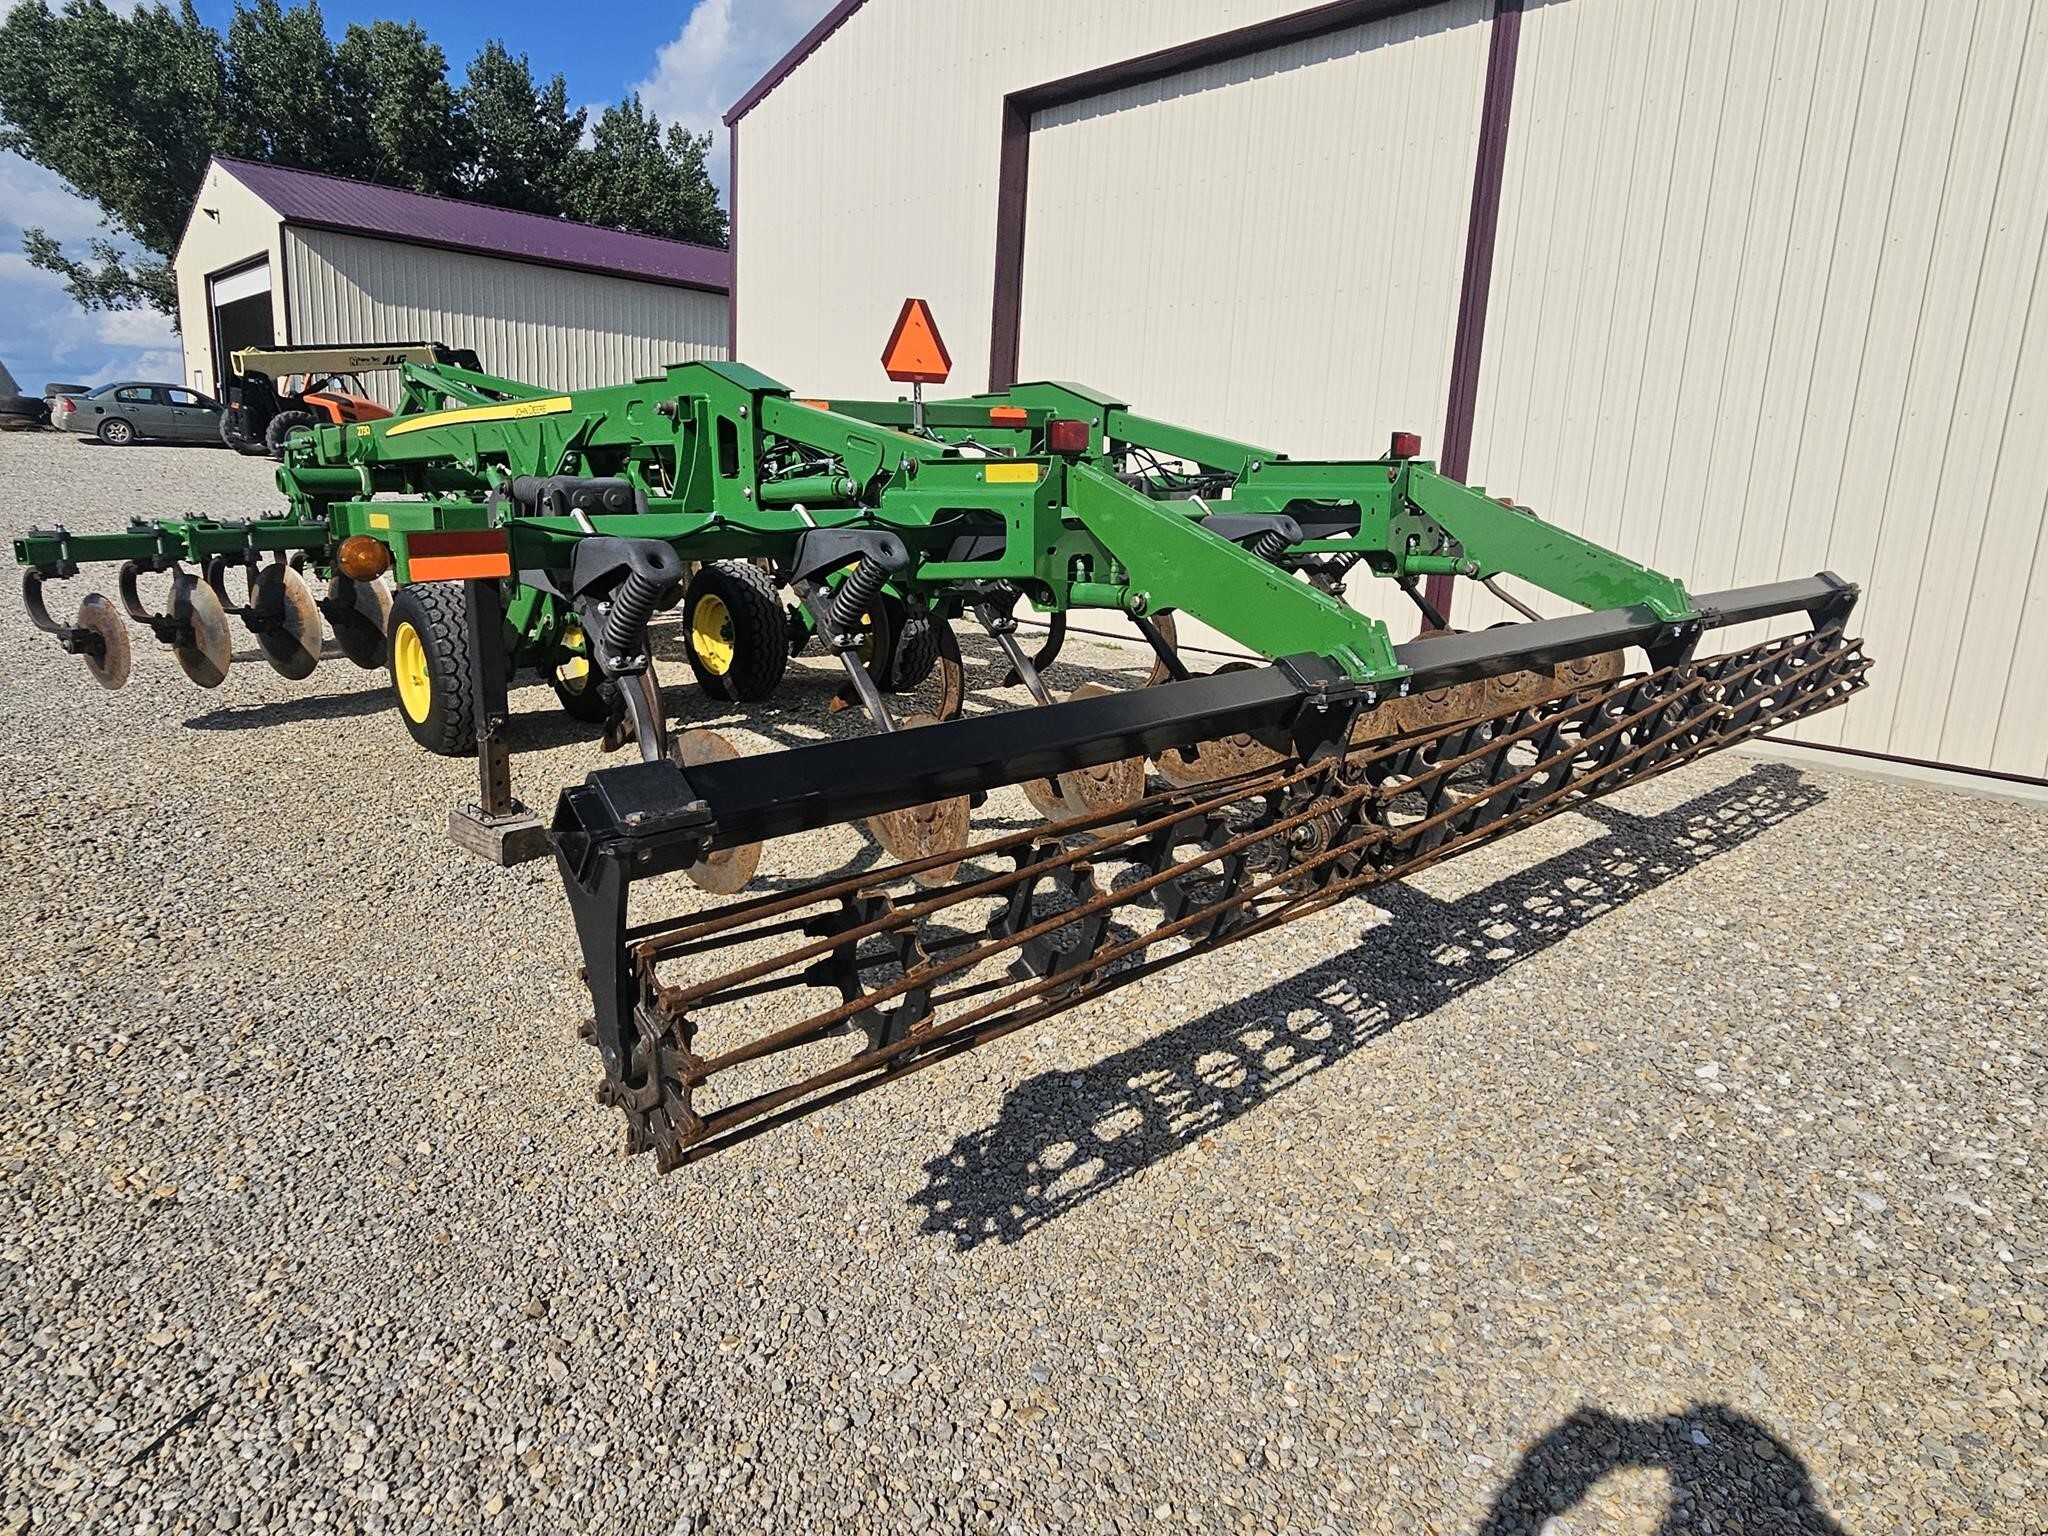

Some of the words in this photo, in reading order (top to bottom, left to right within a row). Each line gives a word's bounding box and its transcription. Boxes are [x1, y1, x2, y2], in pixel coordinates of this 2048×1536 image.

[382, 354, 407, 365] JLG
[514, 407, 529, 417] JOHN
[528, 404, 547, 415] DEERE
